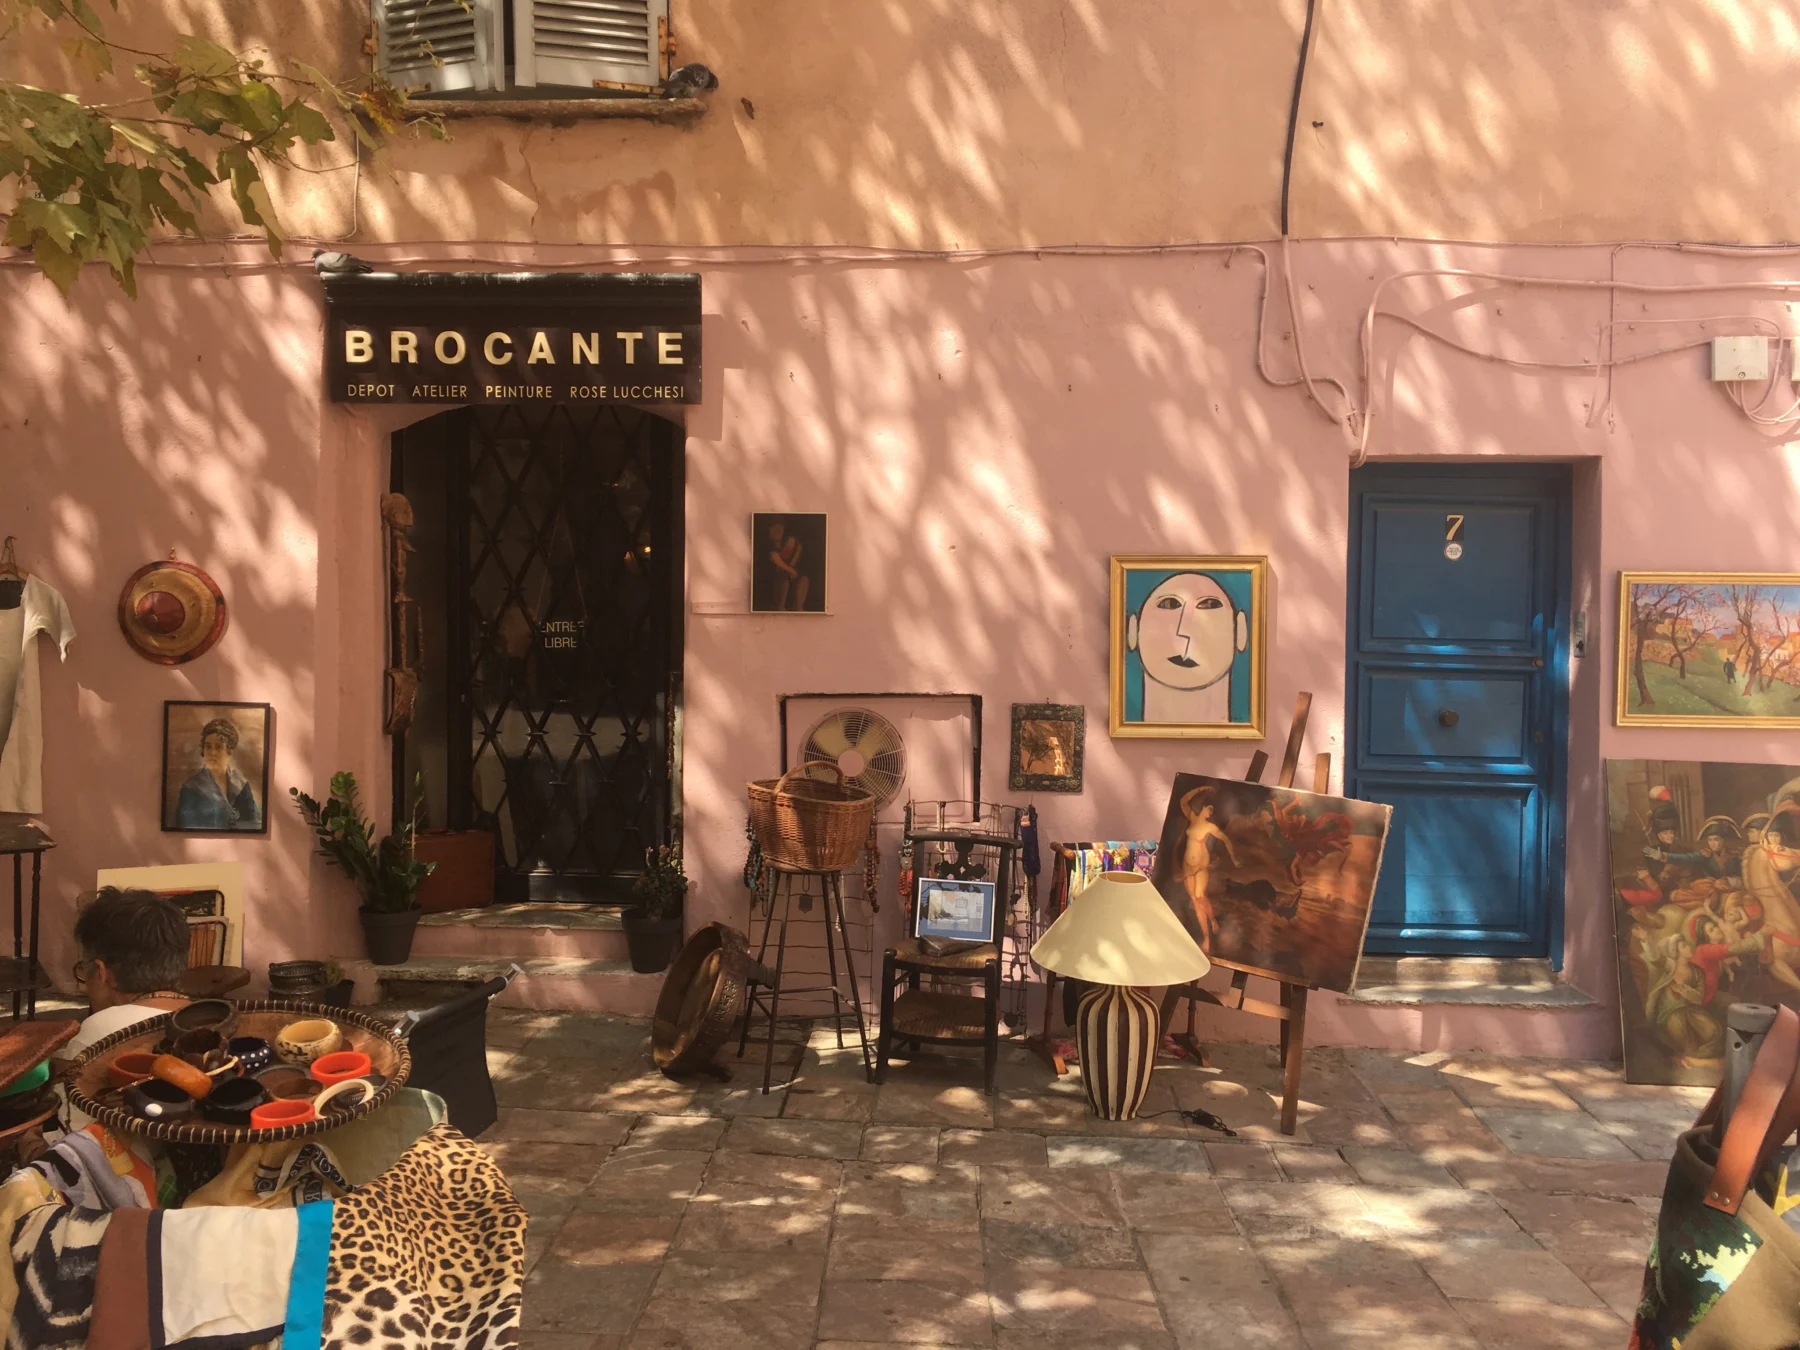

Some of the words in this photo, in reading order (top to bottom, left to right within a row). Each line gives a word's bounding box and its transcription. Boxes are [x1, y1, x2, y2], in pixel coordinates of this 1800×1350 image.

[345, 330, 684, 365] BROCANTE
[347, 384, 395, 397] DEPOT
[412, 385, 467, 398] ATELIER
[485, 385, 553, 398] PEINTURE
[570, 386, 607, 398] ROSE
[613, 386, 684, 398] LUCCHESI
[1446, 514, 1464, 541] 7
[544, 637, 577, 649] LIBRE
